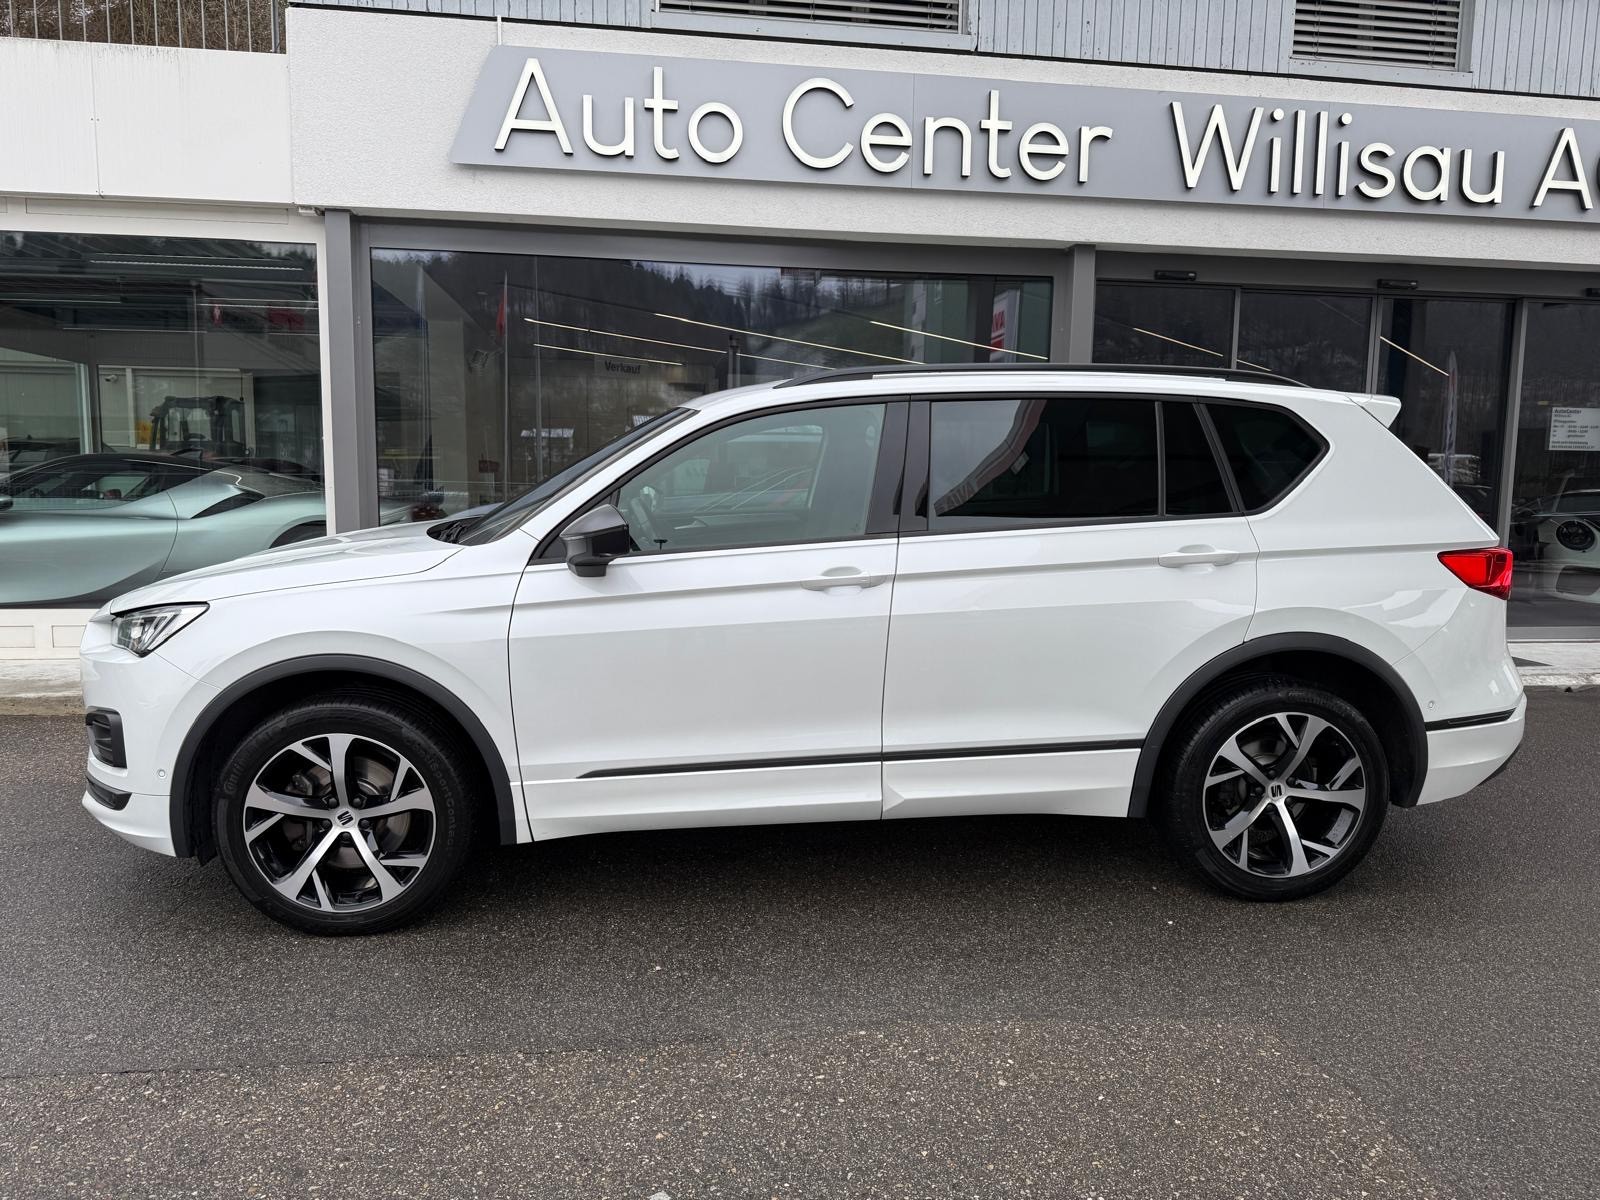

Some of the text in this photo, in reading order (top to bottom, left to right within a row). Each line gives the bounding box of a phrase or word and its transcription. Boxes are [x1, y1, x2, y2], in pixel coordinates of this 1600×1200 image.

[494, 57, 1600, 210] Auto Center Willisau A
[604, 360, 641, 374] Verkauf
